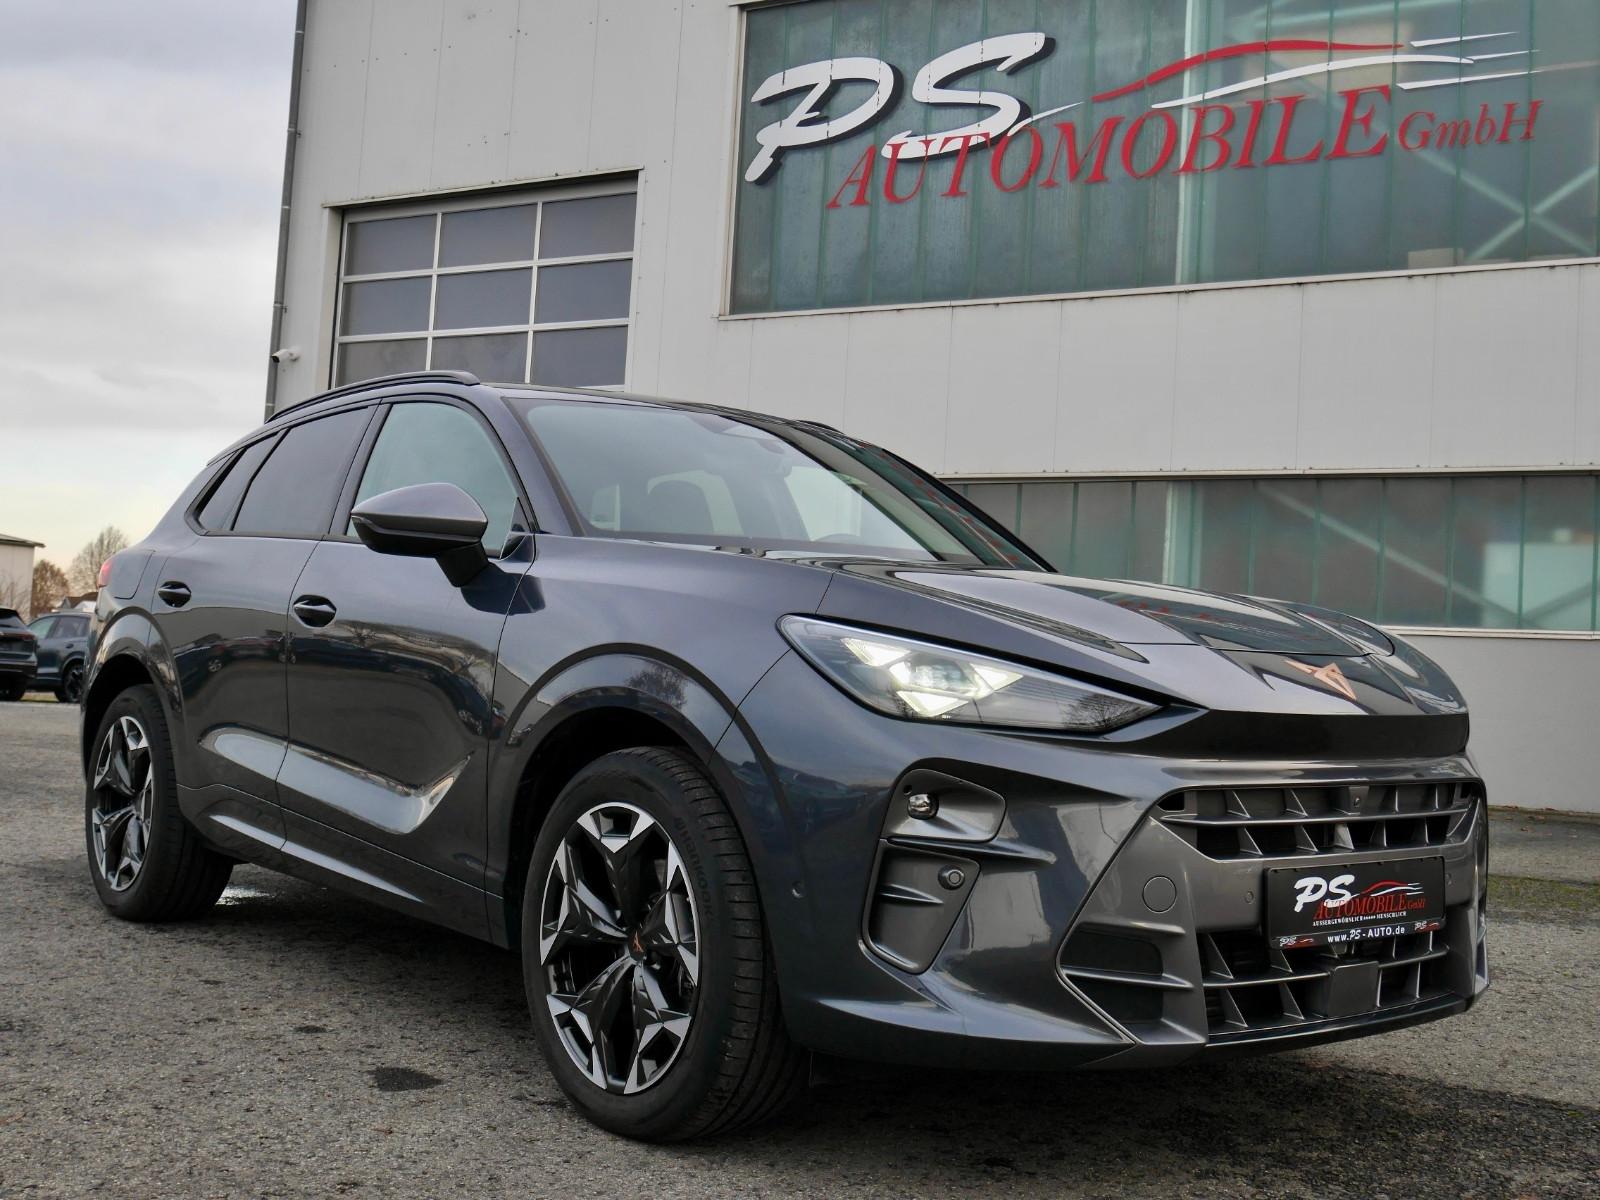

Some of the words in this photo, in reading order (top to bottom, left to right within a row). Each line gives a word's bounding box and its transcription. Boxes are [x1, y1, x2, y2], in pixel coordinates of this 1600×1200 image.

[744, 32, 1056, 185] PS
[826, 84, 1393, 209] AUTOMOBILE
[1397, 99, 1543, 153] GmbH
[1293, 874, 1356, 913] PS
[1312, 894, 1408, 920] AUTOMOBILE
